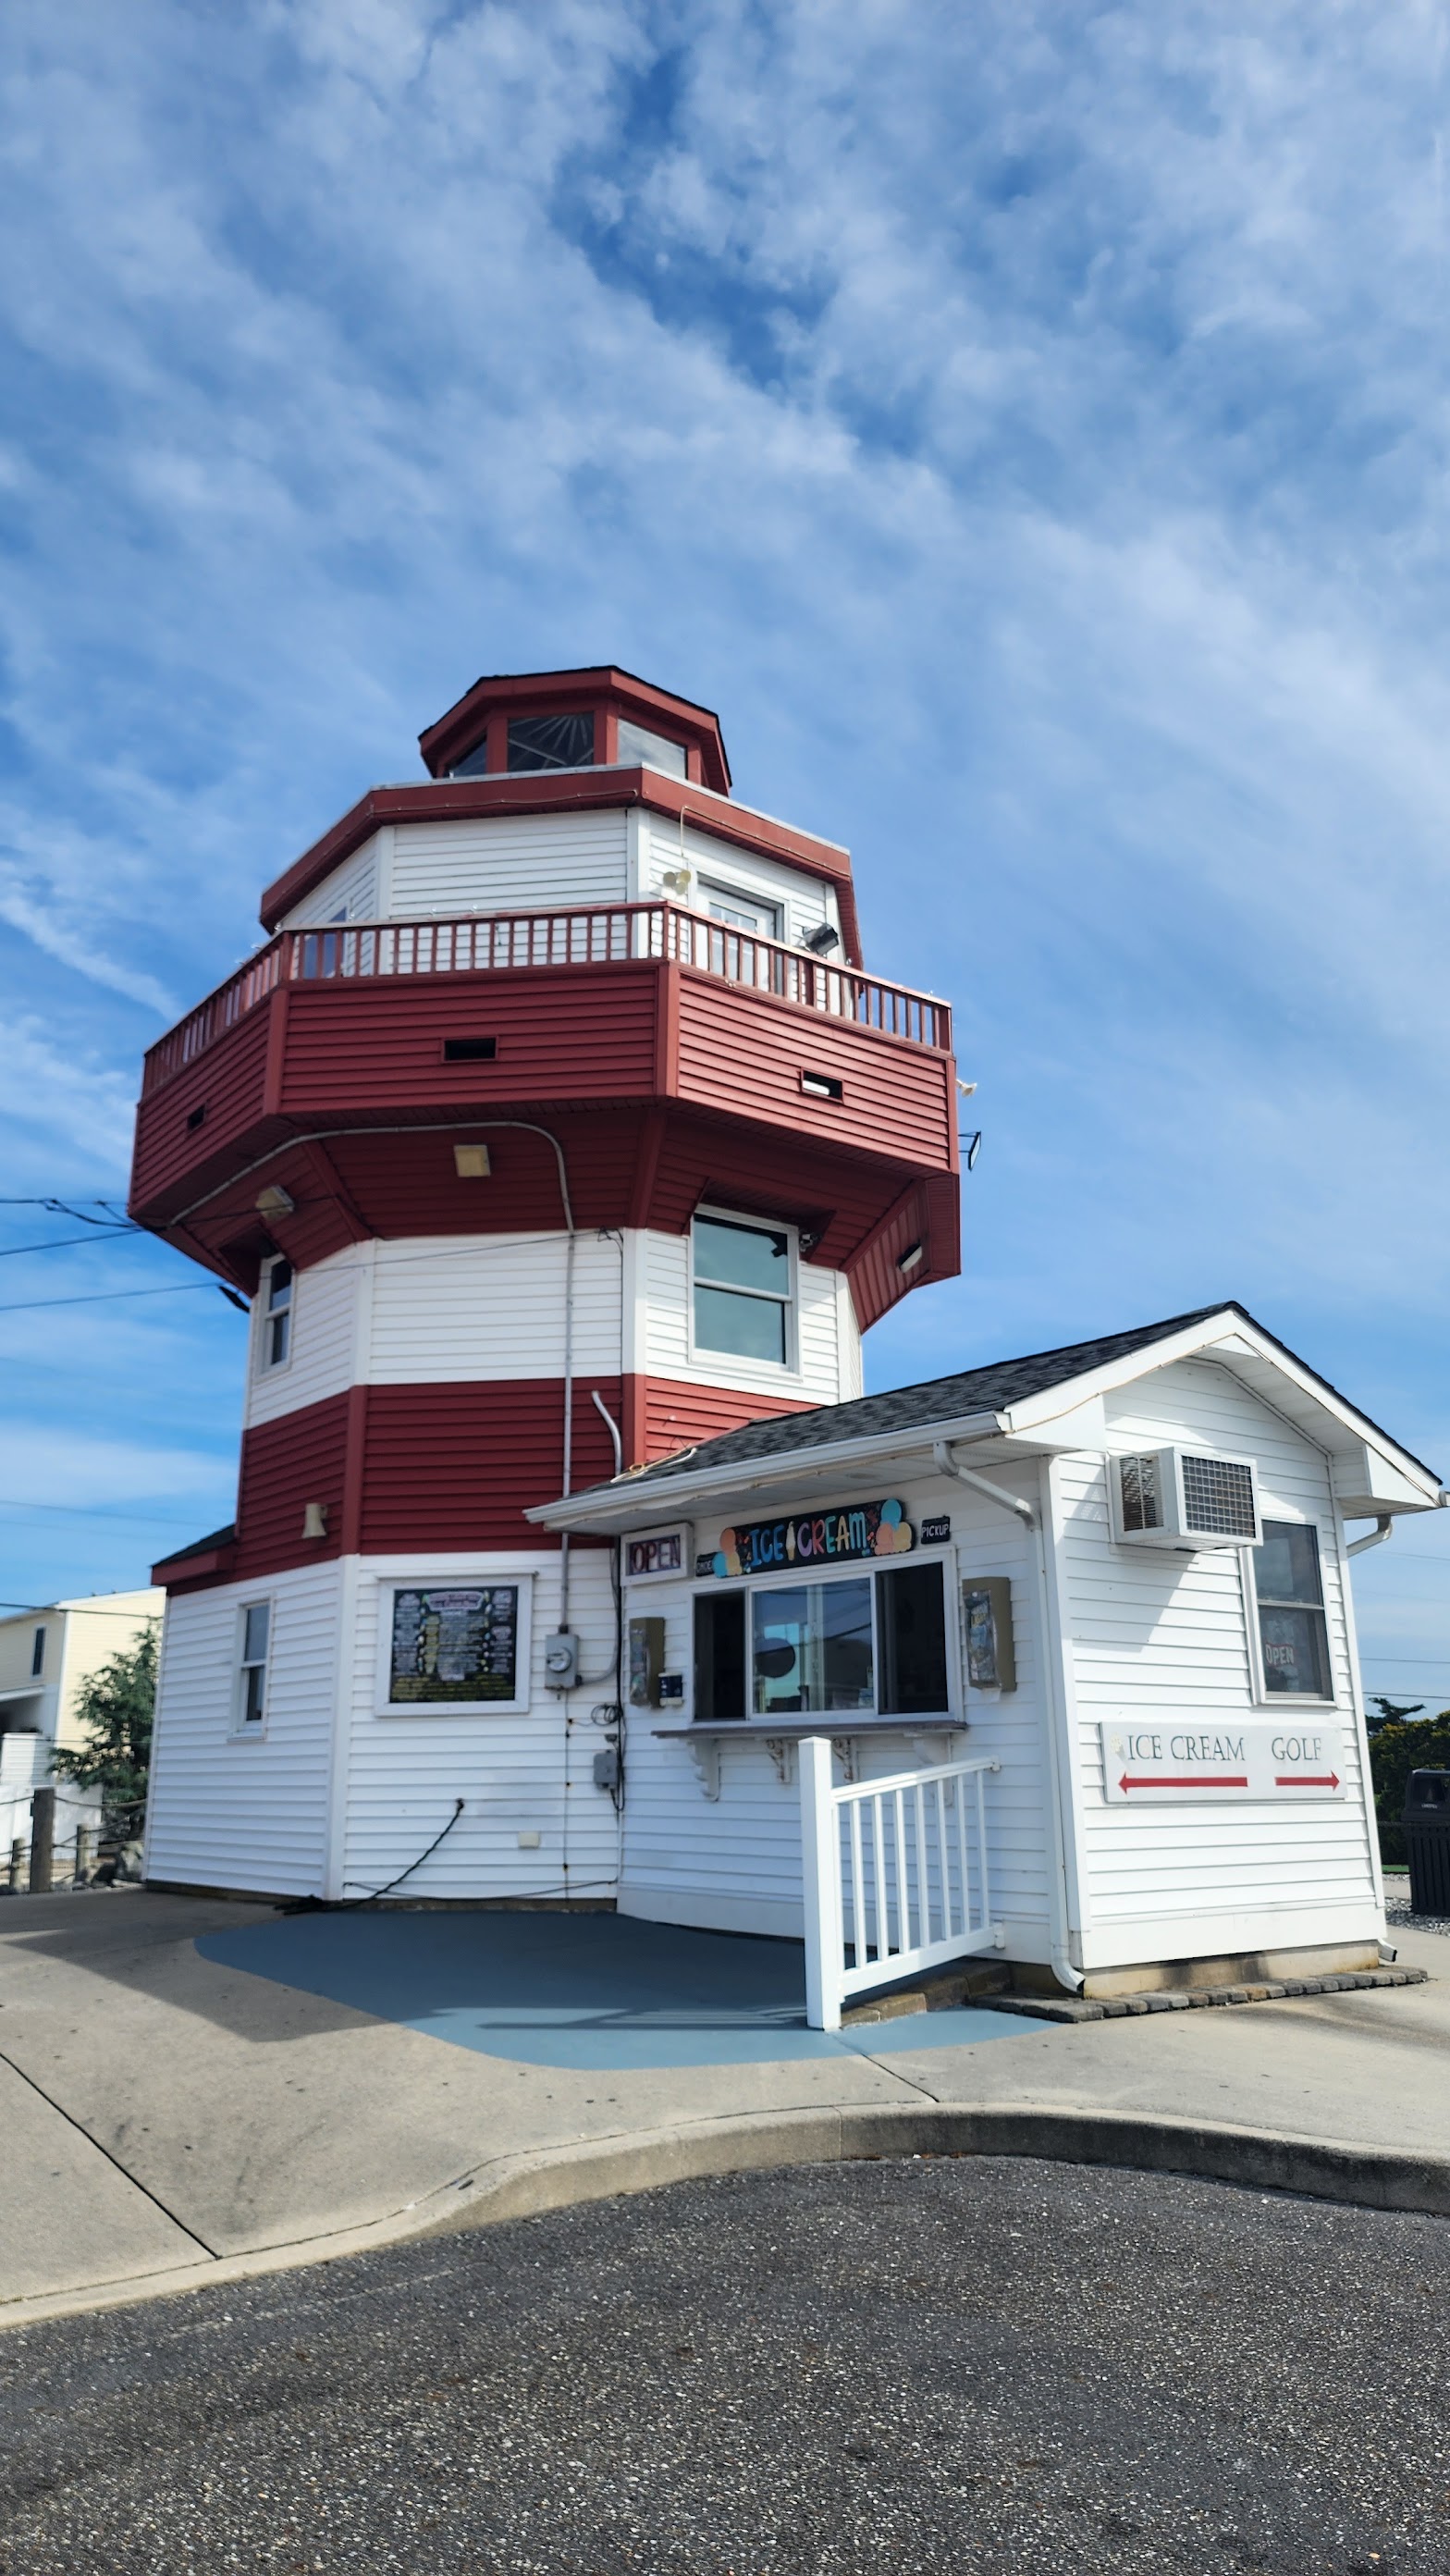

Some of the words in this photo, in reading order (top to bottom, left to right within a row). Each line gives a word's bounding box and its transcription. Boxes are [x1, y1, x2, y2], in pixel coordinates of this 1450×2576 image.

[748, 1524, 784, 1567] ICE
[797, 1511, 866, 1558] CREAM
[921, 1523, 949, 1538] PICKUP
[633, 1537, 681, 1571] OPEN
[1265, 1644, 1295, 1666] OPEN
[1127, 1734, 1163, 1760] ICE
[1170, 1735, 1247, 1761] CREAM
[1271, 1737, 1321, 1761] GOLF
